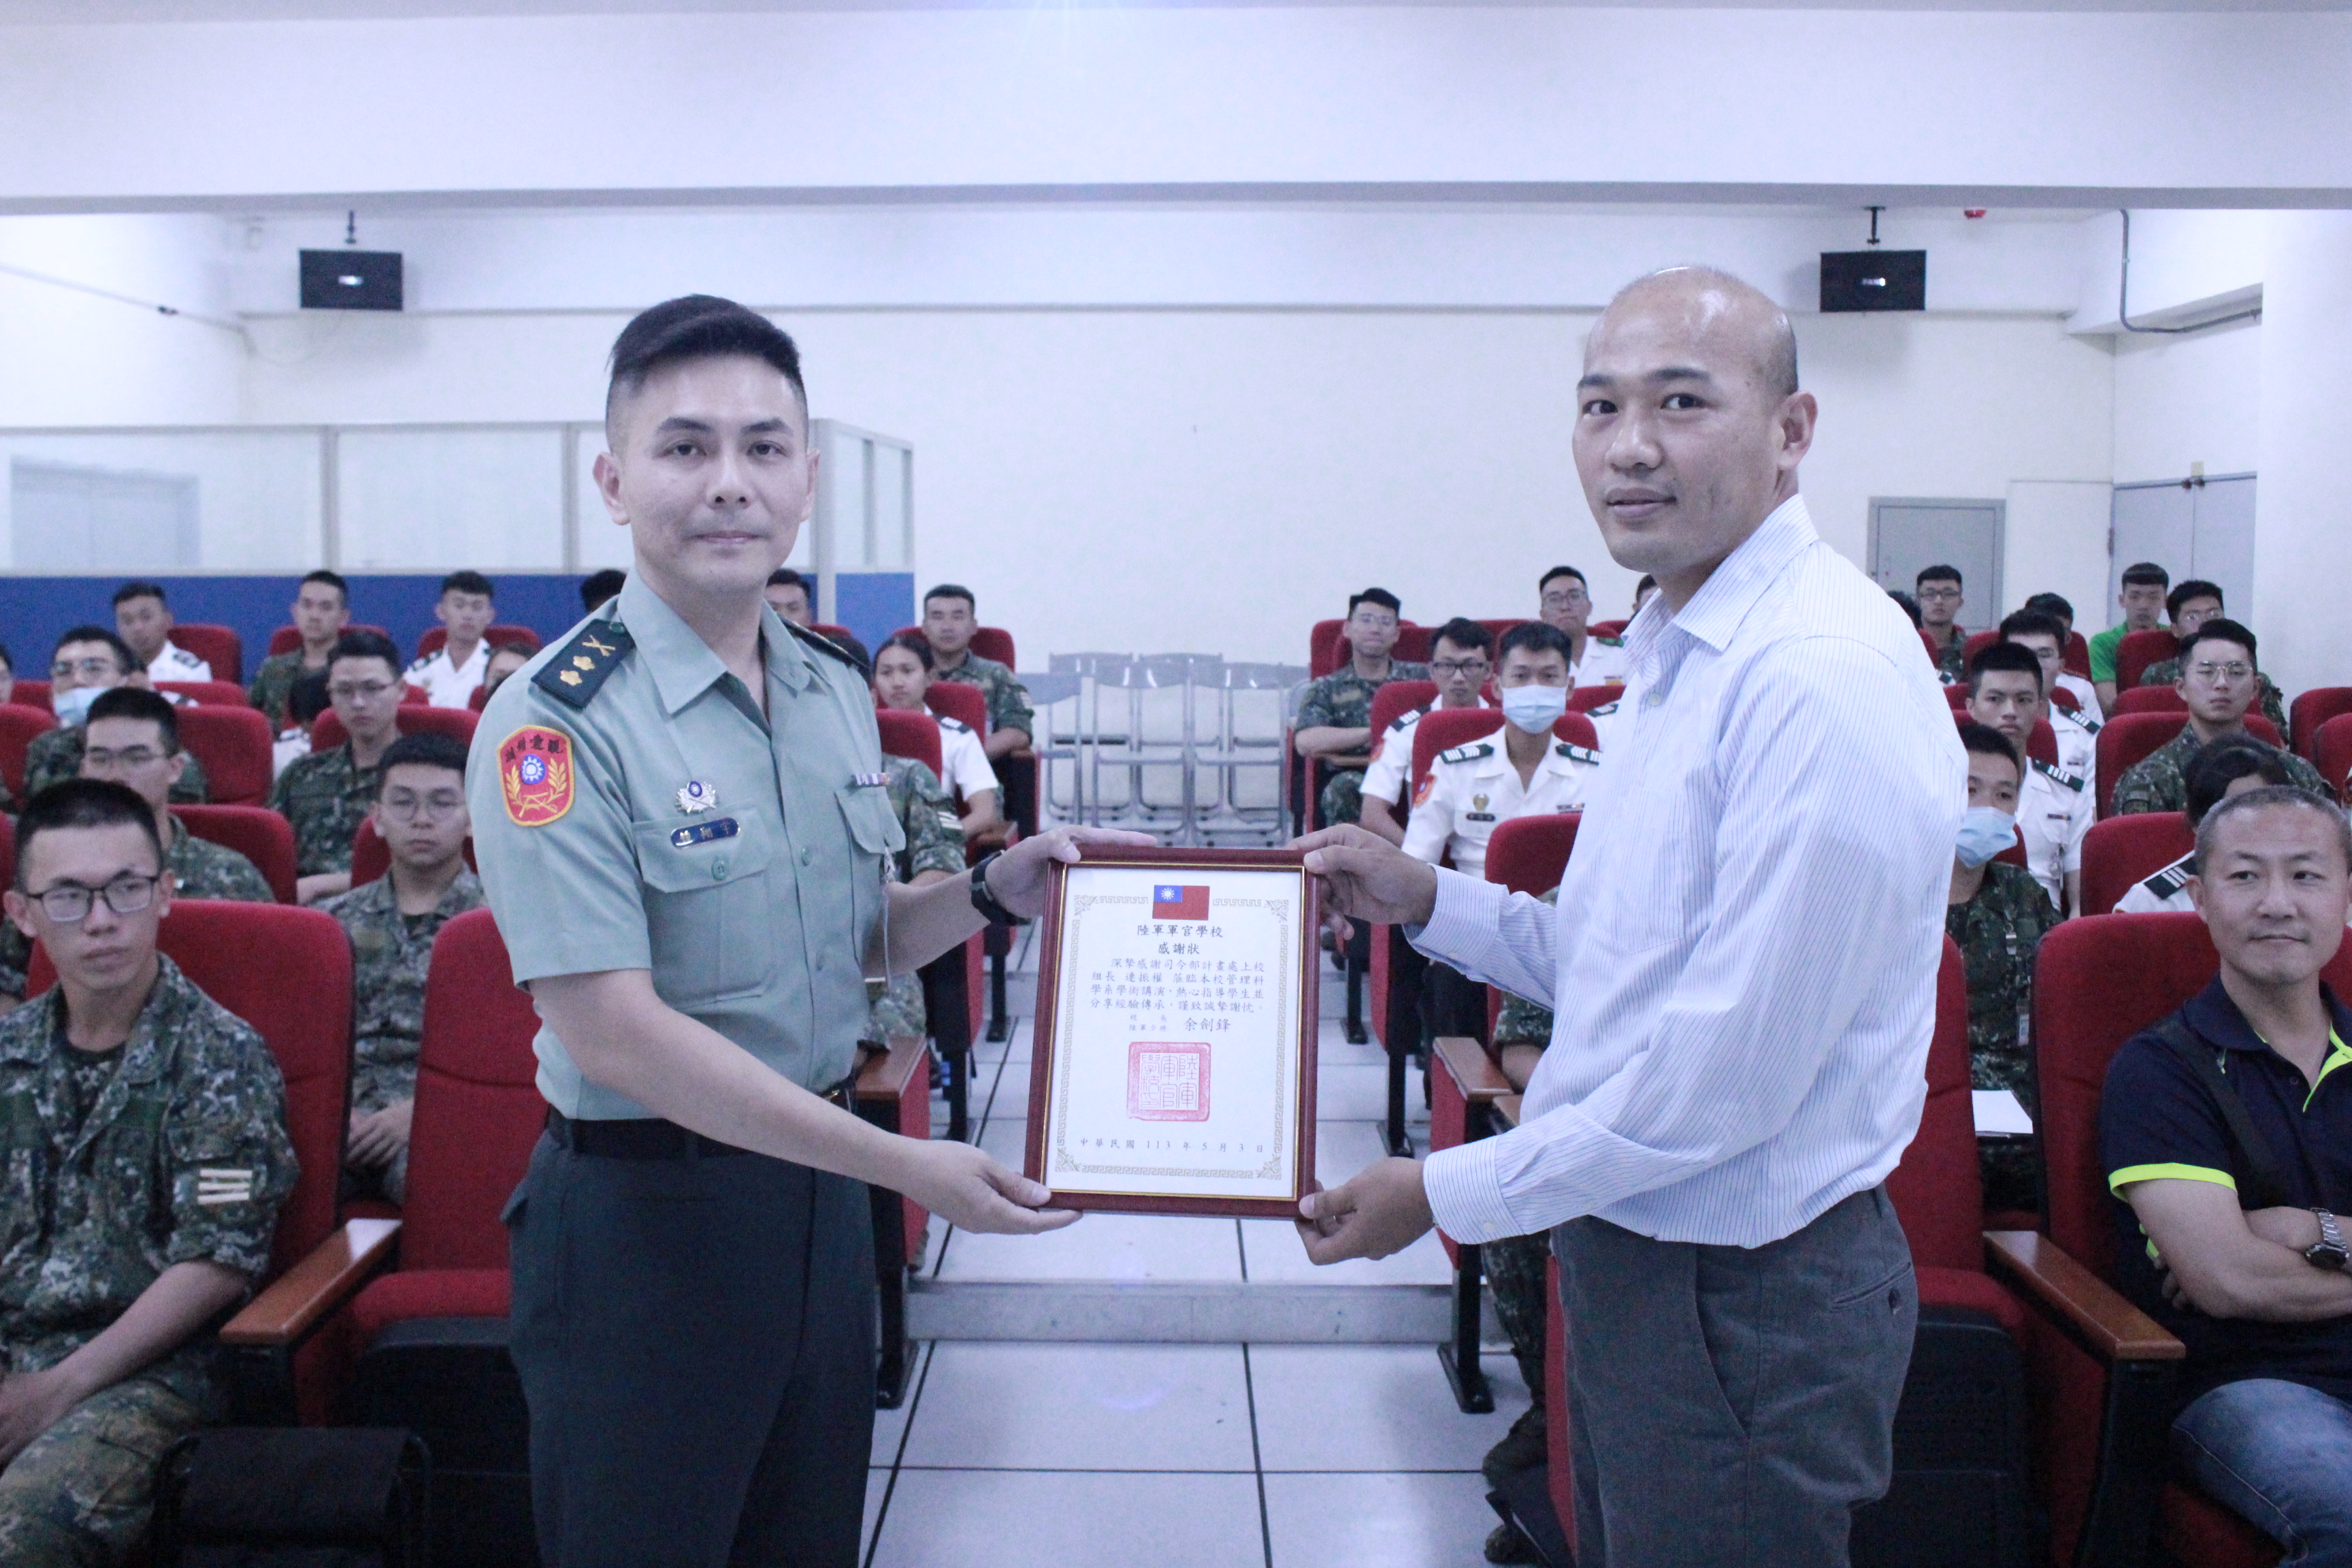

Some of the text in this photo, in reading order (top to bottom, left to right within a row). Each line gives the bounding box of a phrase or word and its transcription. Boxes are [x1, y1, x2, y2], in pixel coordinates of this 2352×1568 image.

[1137, 924, 1224, 938] 陸軍軍官學校
[1158, 942, 1200, 954] 感謝狀
[1184, 1017, 1230, 1032] 余劍鋒
